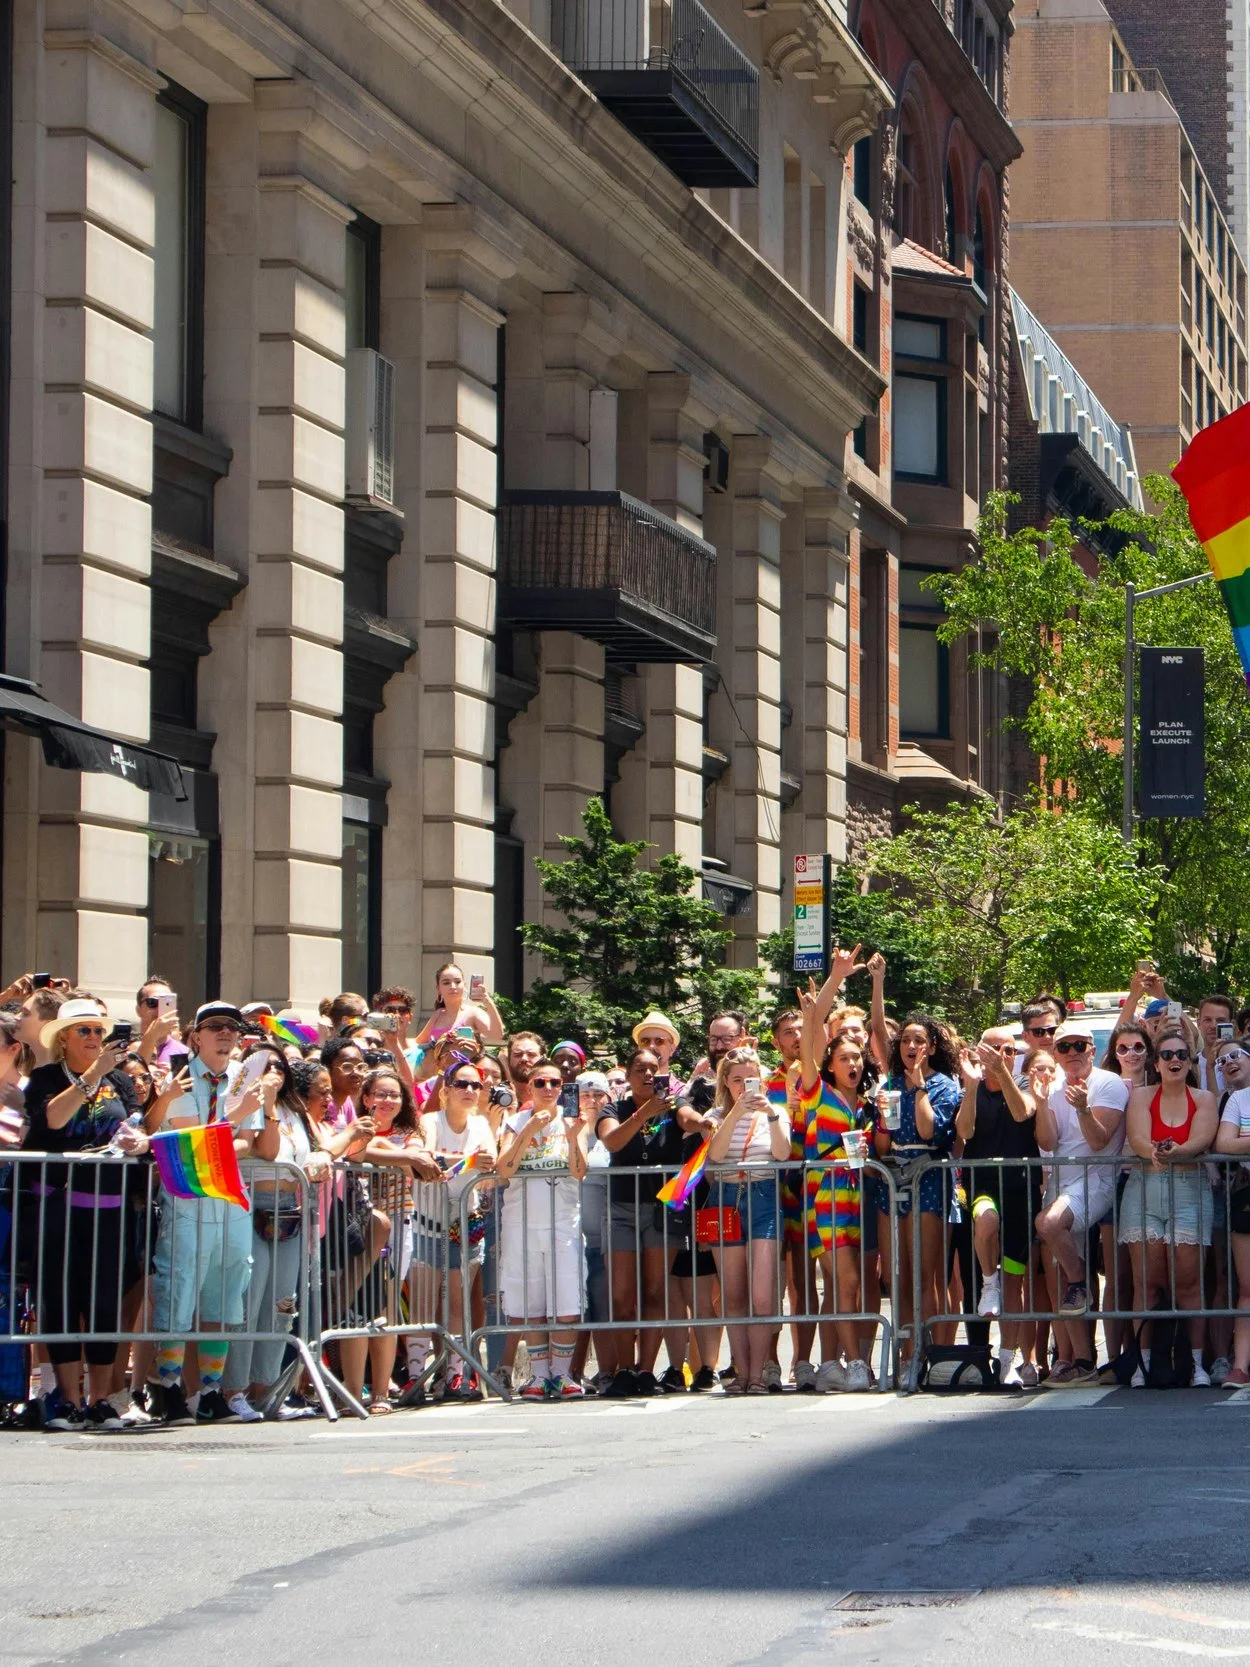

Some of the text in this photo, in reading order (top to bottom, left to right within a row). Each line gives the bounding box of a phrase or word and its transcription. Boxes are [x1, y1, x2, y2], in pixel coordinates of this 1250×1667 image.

[1161, 655, 1184, 664] NYC
[797, 905, 805, 918] 2
[795, 958, 822, 969] 102667
[519, 1160, 570, 1171] TRAIGHT
